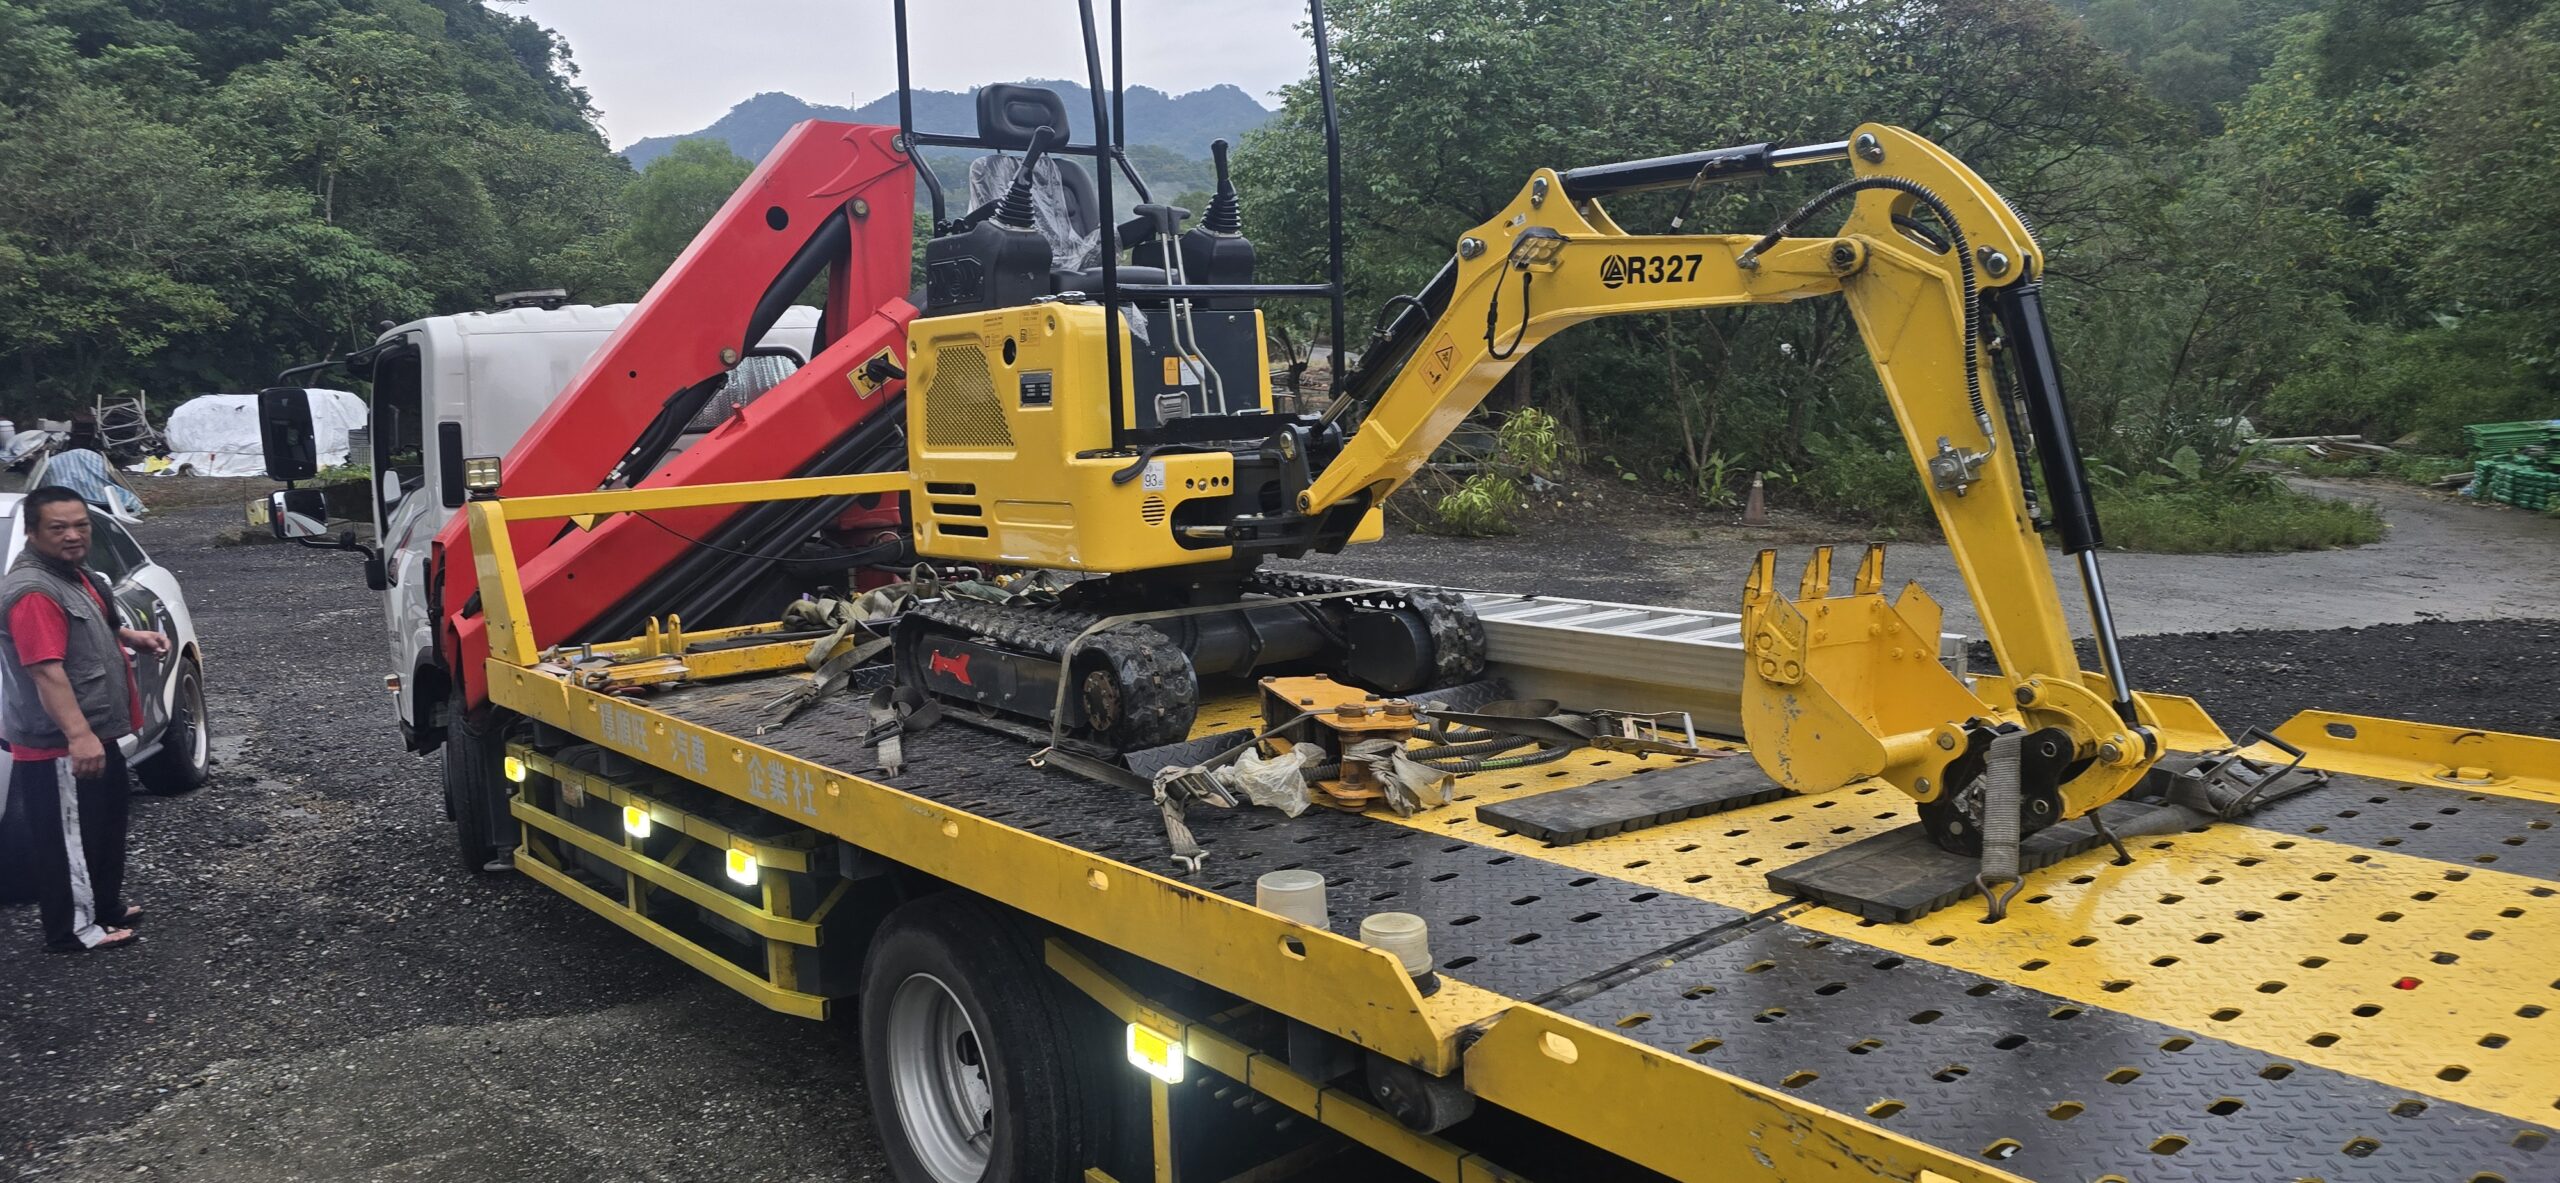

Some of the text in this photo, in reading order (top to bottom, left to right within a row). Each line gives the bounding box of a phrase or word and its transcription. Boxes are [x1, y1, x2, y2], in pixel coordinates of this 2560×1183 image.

[1627, 254, 1703, 284] R327
[1145, 474, 1157, 487] 93
[669, 727, 709, 777] 汽車
[747, 754, 818, 817] 企業社
